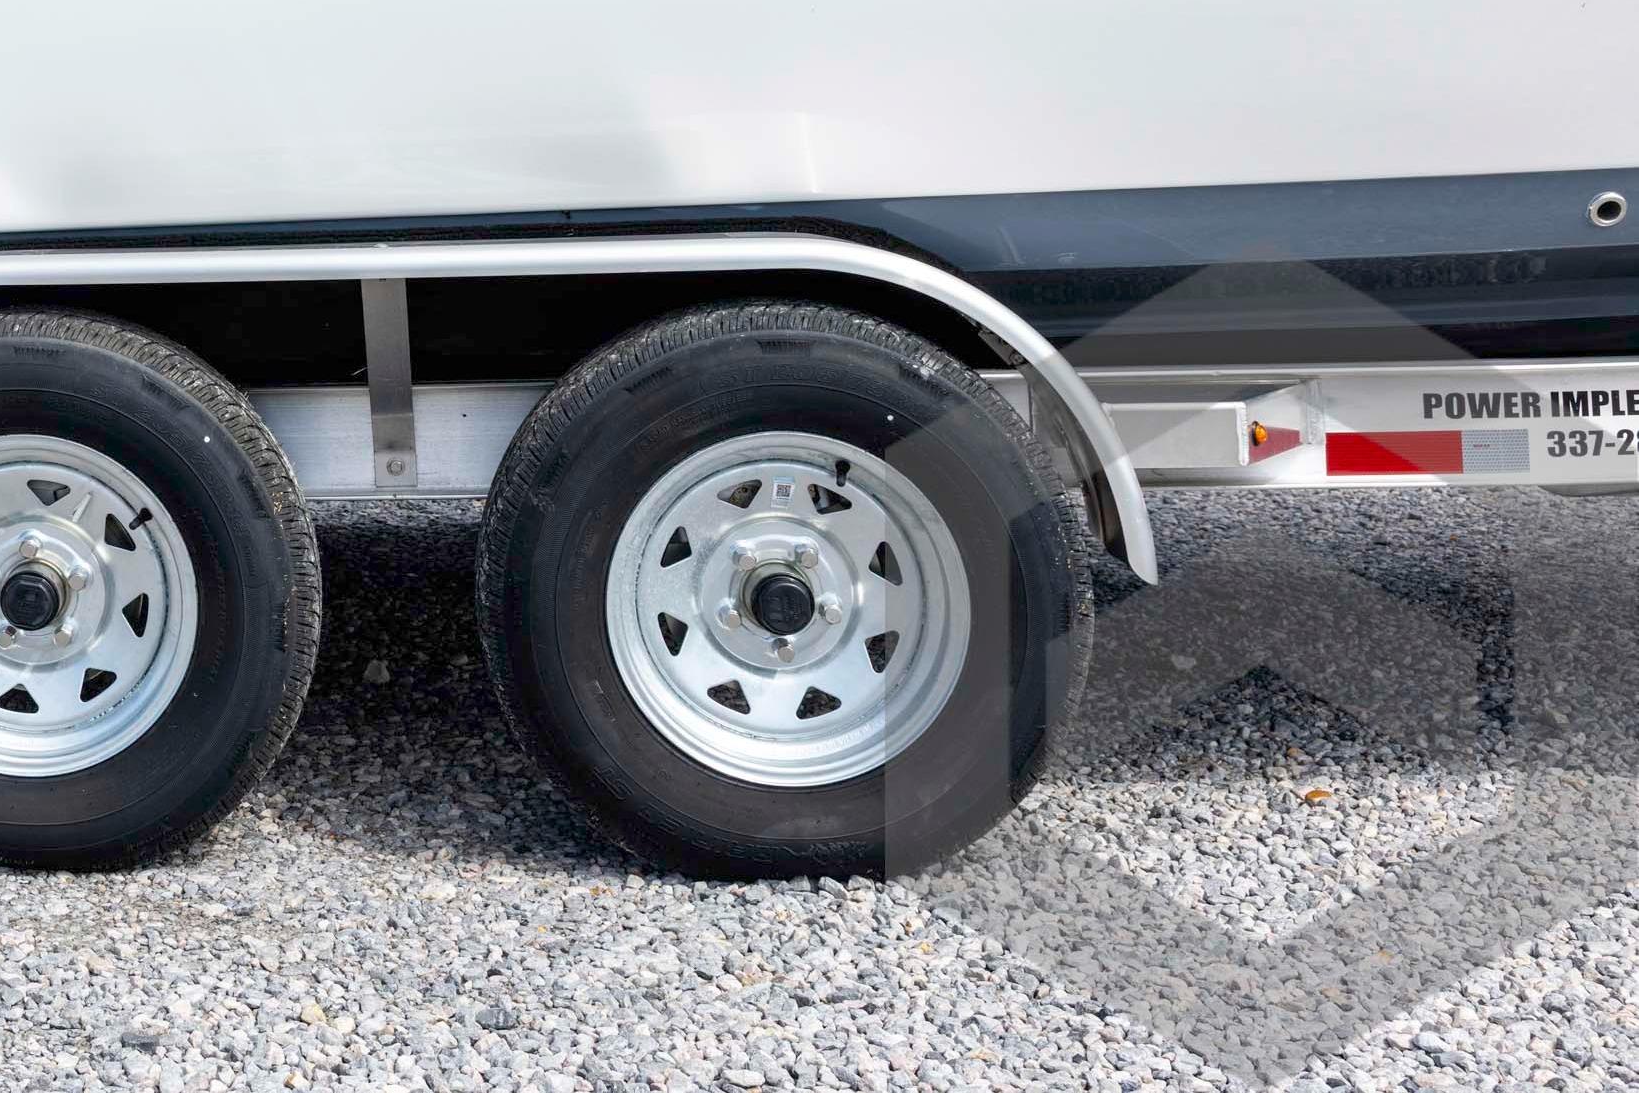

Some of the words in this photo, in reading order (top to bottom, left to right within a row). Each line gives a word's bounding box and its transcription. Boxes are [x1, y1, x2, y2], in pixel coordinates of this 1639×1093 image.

[1423, 390, 1542, 420] POWER
[1550, 389, 1639, 417] IMPLE
[1546, 428, 1639, 458] 337-2
